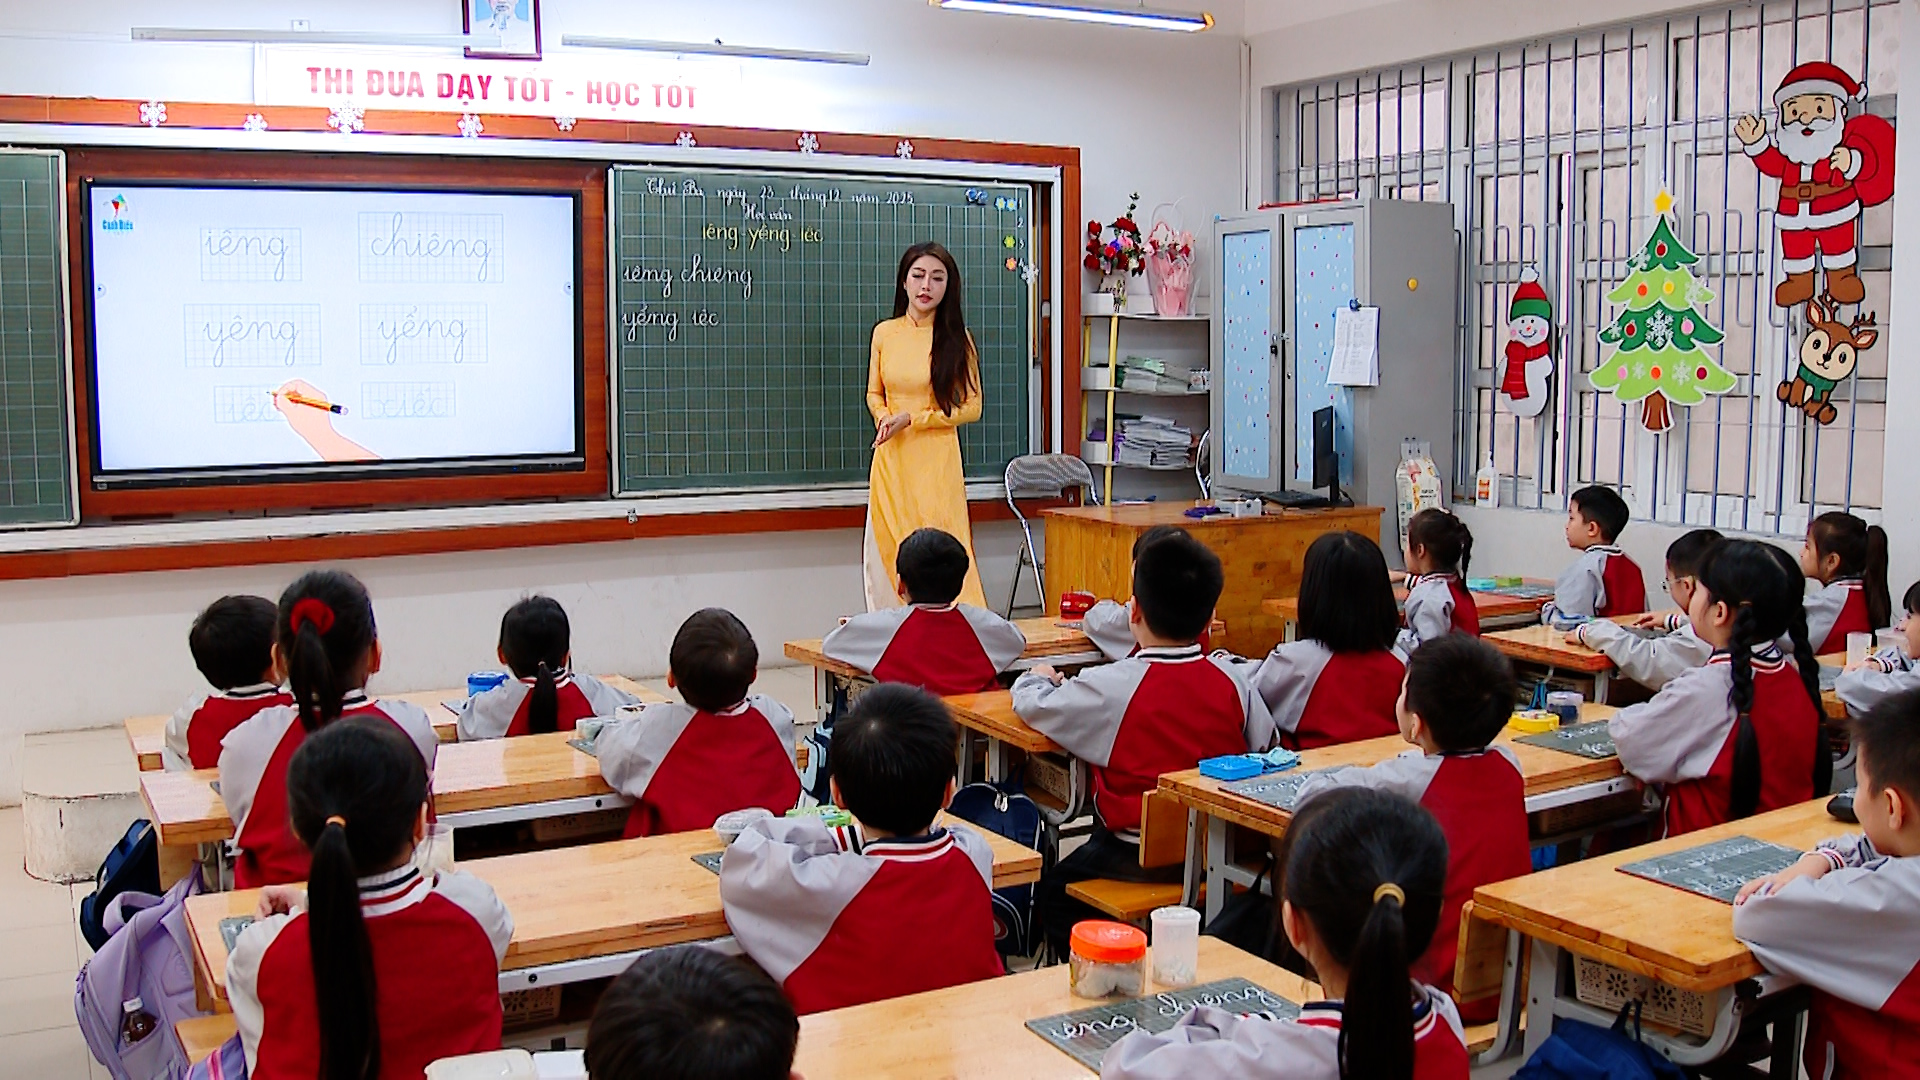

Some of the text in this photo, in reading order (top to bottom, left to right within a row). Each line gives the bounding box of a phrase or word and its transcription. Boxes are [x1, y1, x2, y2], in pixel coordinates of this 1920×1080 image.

[307, 67, 353, 95] THI
[366, 69, 425, 98] ĐUA
[437, 73, 492, 105] DẠY
[587, 80, 640, 111] HỌC
[205, 230, 289, 282] iêng
[371, 212, 492, 283] chiêng
[203, 315, 299, 368] yêng
[377, 306, 467, 364] yểng
